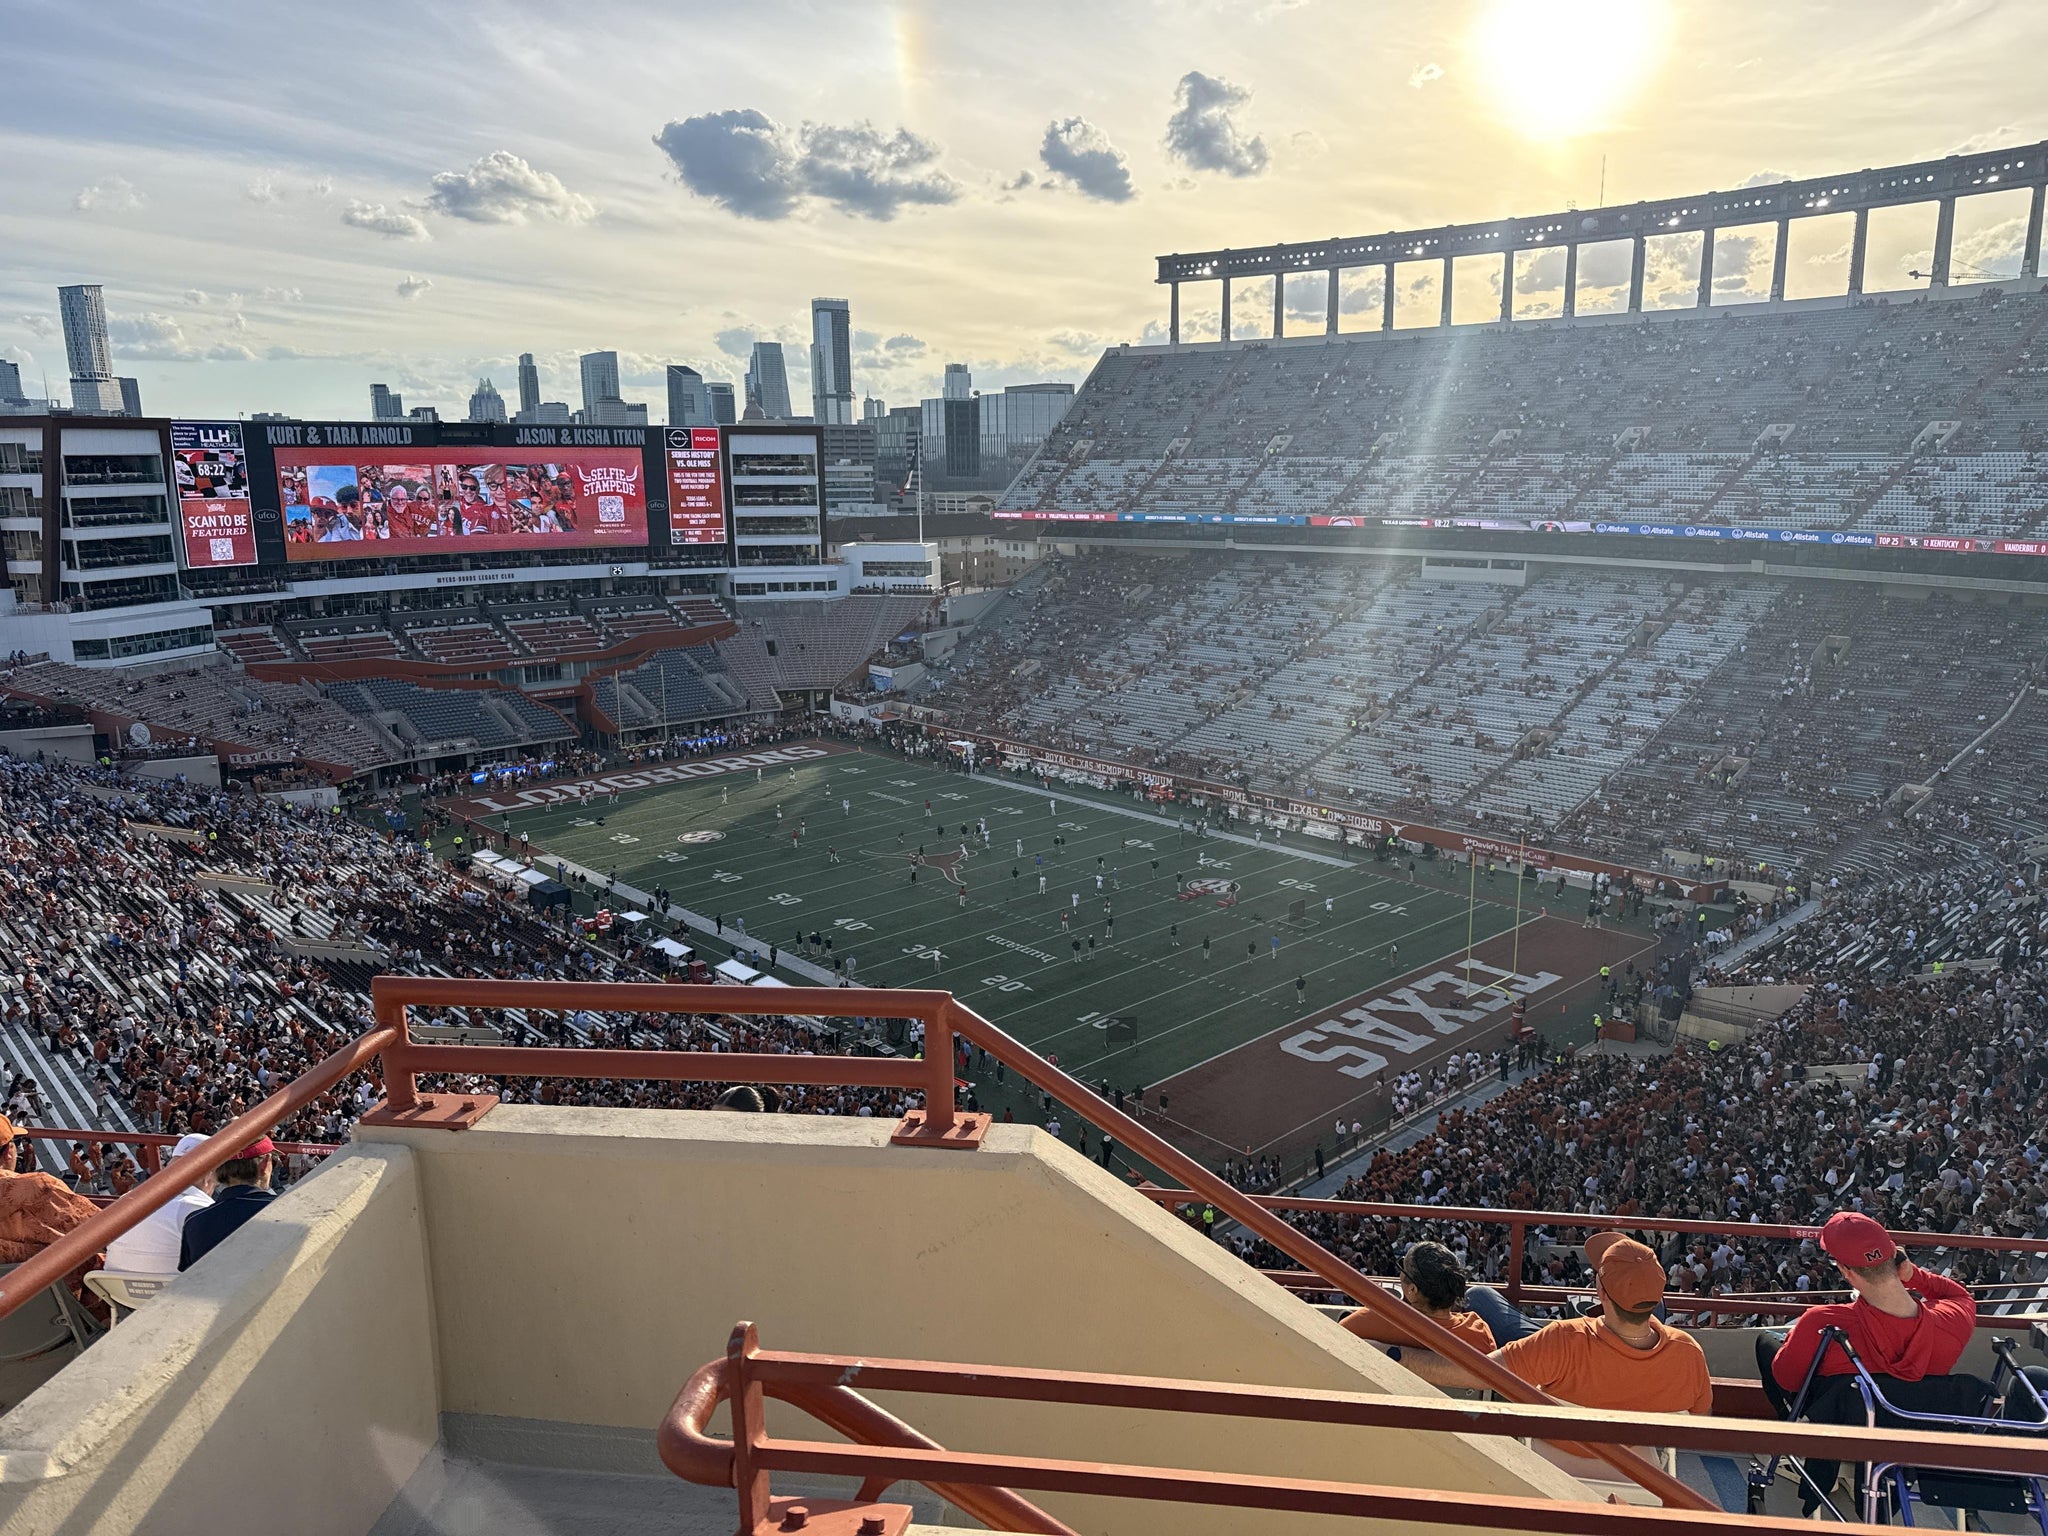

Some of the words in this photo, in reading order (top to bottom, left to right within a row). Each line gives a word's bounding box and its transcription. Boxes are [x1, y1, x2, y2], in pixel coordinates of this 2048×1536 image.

[199, 429, 230, 443] LLH
[266, 426, 302, 445] KURT
[307, 426, 321, 444] &
[325, 427, 359, 445] TARA
[361, 427, 412, 445] ARNOLD
[516, 428, 556, 445] JASON
[560, 428, 573, 445] &
[573, 428, 611, 445] KISHA
[613, 429, 646, 445] ITKIN
[198, 464, 225, 476] 68:22
[590, 467, 626, 481] SELFIE
[583, 480, 636, 496] STAMPEDE
[188, 516, 217, 528] SCAN
[218, 515, 232, 527] TO
[234, 514, 248, 526] BE
[258, 511, 276, 519] ufcu
[192, 527, 247, 537] FEATURED
[1606, 525, 1630, 533] Allstate
[1650, 527, 1674, 535] Allstate
[1695, 529, 1720, 537] Allstate
[1743, 531, 1769, 539] Allstate
[1792, 533, 1819, 541] Allstate
[1844, 535, 1873, 544] Allstate
[1879, 537, 1890, 545] TOP
[1891, 537, 1899, 546] 25
[1929, 539, 1958, 549] KENTUCKY
[1965, 541, 1970, 549] 0
[2004, 543, 2037, 553] VANDERBILT
[2041, 544, 2046, 553] 0
[612, 566, 622, 575] 25
[232, 750, 280, 764] TEXAS
[470, 746, 828, 812] LONGHORNS
[1137, 771, 1173, 787] STADIUM
[1222, 789, 1248, 803] HOME
[1288, 802, 1318, 817] TEXAS
[609, 832, 640, 844] 20
[657, 850, 689, 863] 30
[711, 869, 743, 883] 40
[768, 893, 803, 906] 50
[833, 918, 868, 931] 40
[902, 944, 941, 960] 30
[980, 975, 1025, 992] 20
[1076, 1011, 1119, 1029] 10
[1279, 958, 1563, 1079] TEXAS
[1864, 1249, 1883, 1262] M
